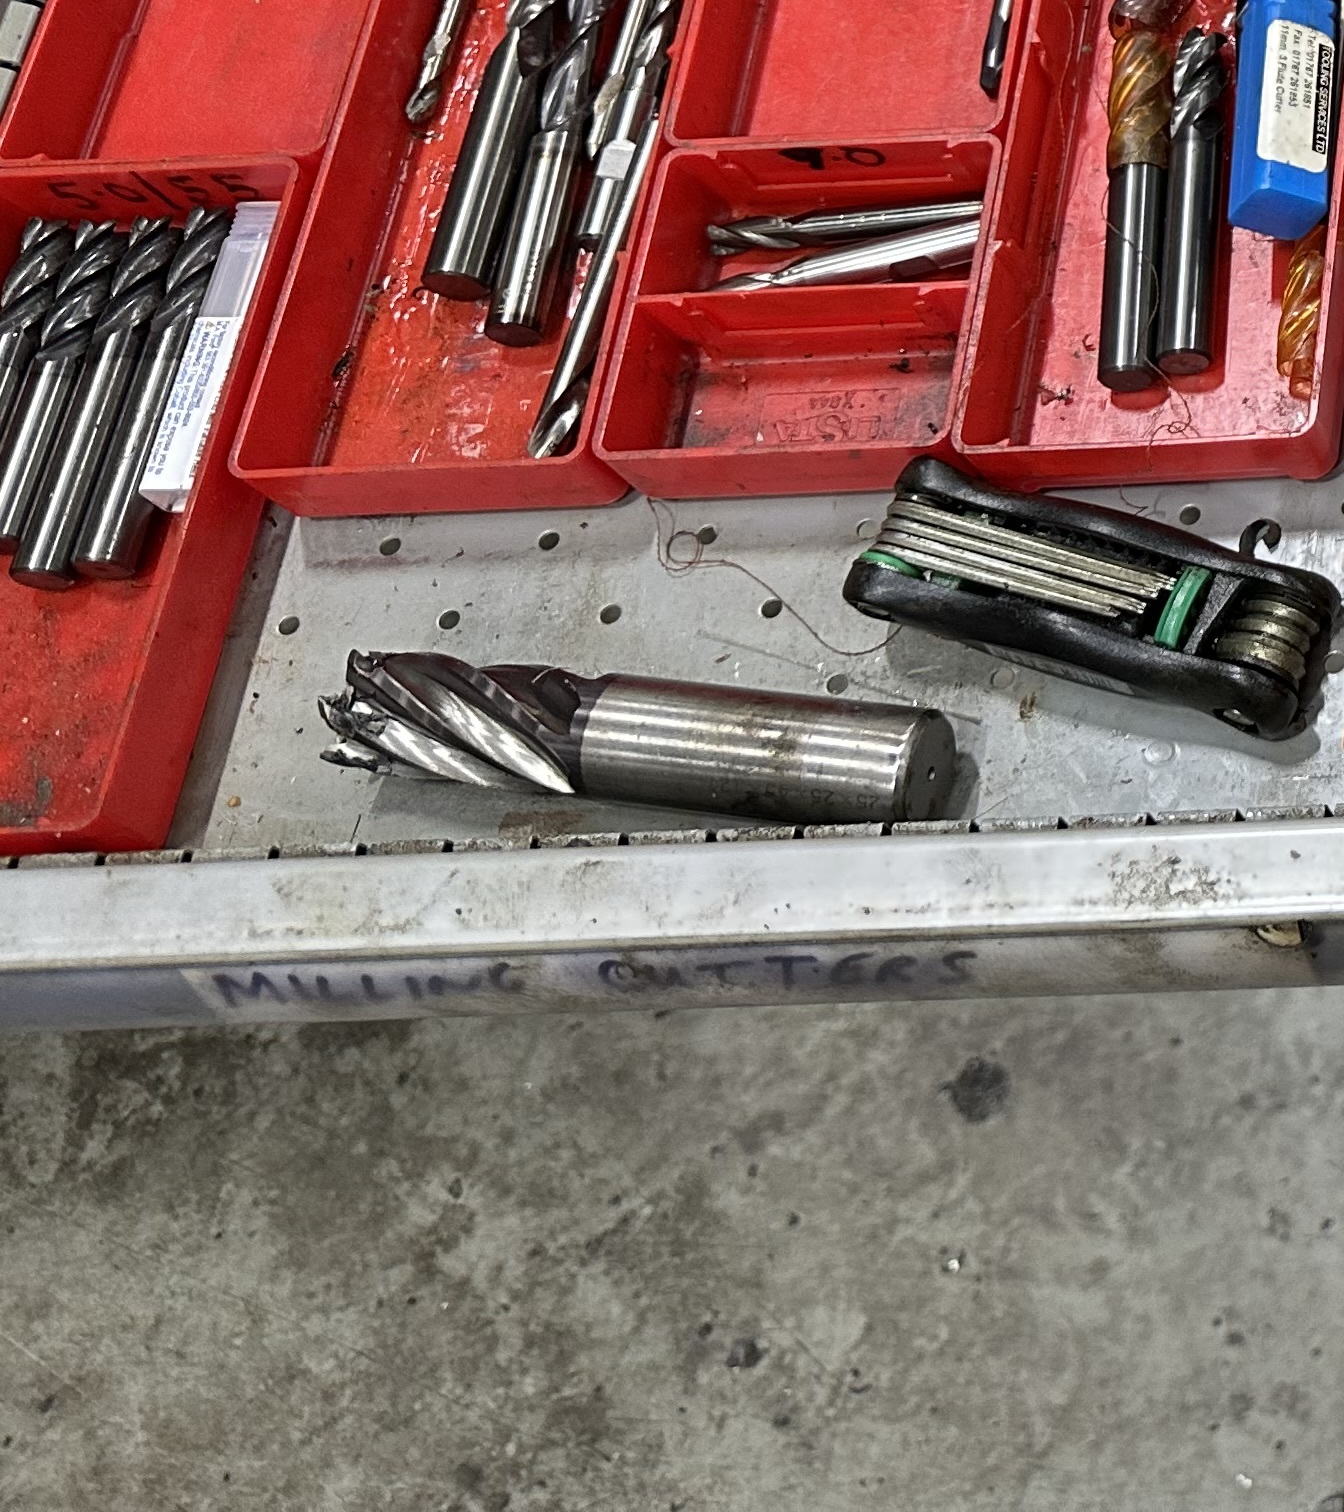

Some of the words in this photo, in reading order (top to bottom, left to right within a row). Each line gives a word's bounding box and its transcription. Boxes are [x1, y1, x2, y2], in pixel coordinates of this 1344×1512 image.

[1318, 44, 1332, 87] TOOLING
[1316, 86, 1328, 133] SERVICES
[1314, 132, 1326, 154] LTD
[211, 961, 528, 1009] MILLING
[598, 949, 980, 993] CUTTERS
